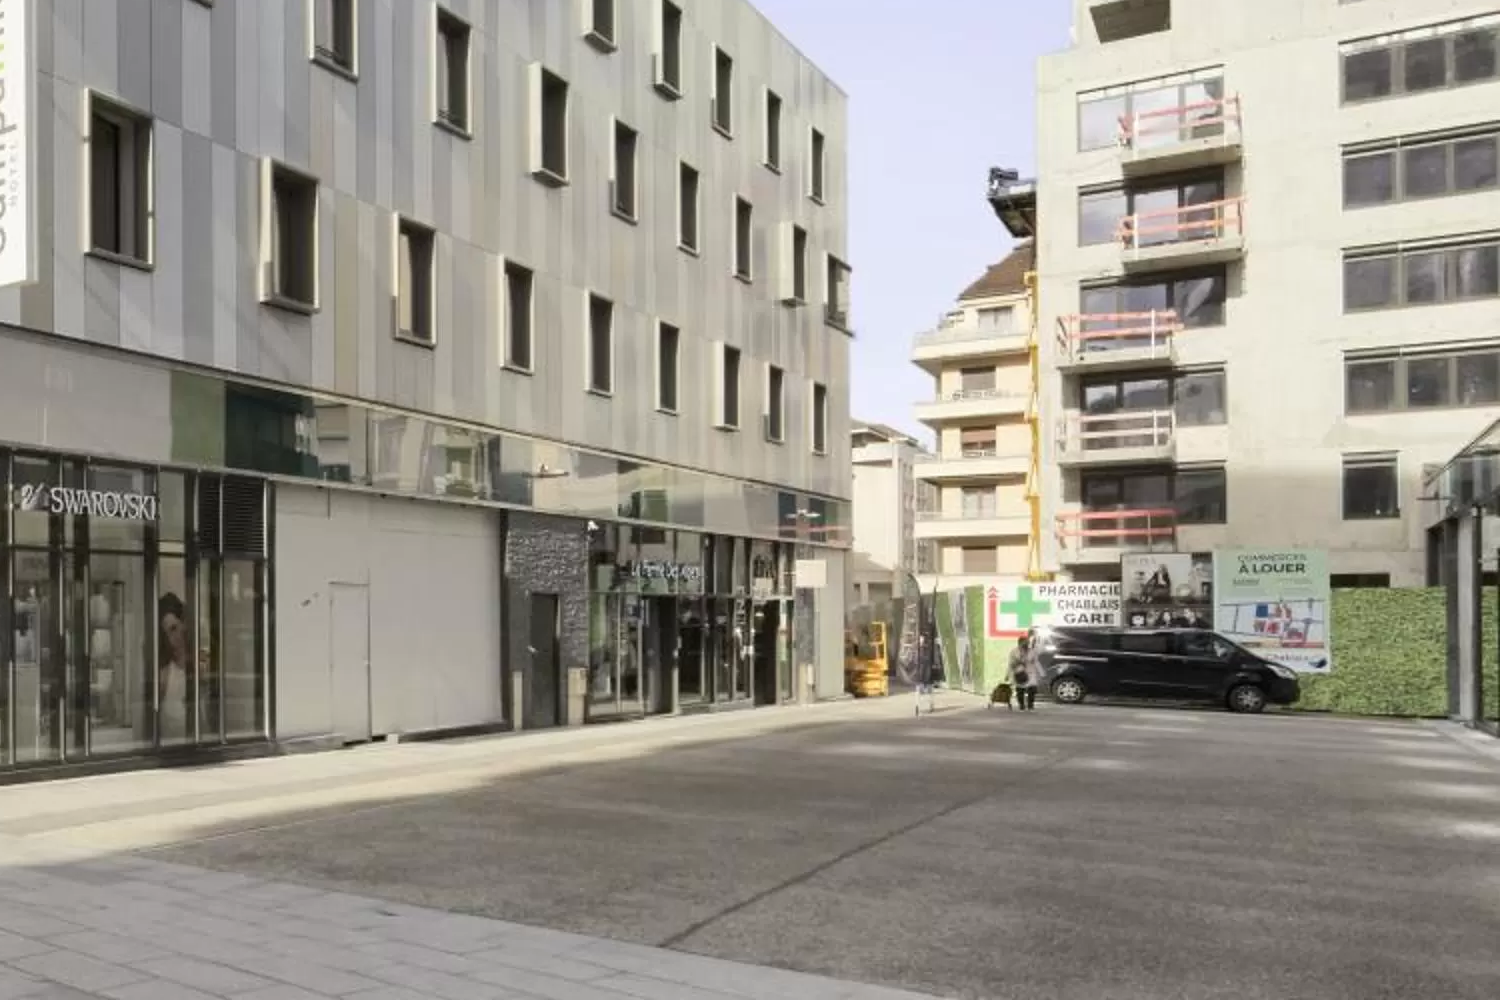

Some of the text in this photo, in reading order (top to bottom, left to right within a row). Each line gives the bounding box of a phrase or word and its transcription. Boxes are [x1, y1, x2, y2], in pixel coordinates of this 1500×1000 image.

[8, 140, 19, 209] HOTEL
[51, 487, 156, 520] SWAROVSKI
[1239, 561, 1305, 574] À LOUER
[1057, 600, 1119, 610] CHABLAIS
[1063, 613, 1114, 624] GARE
